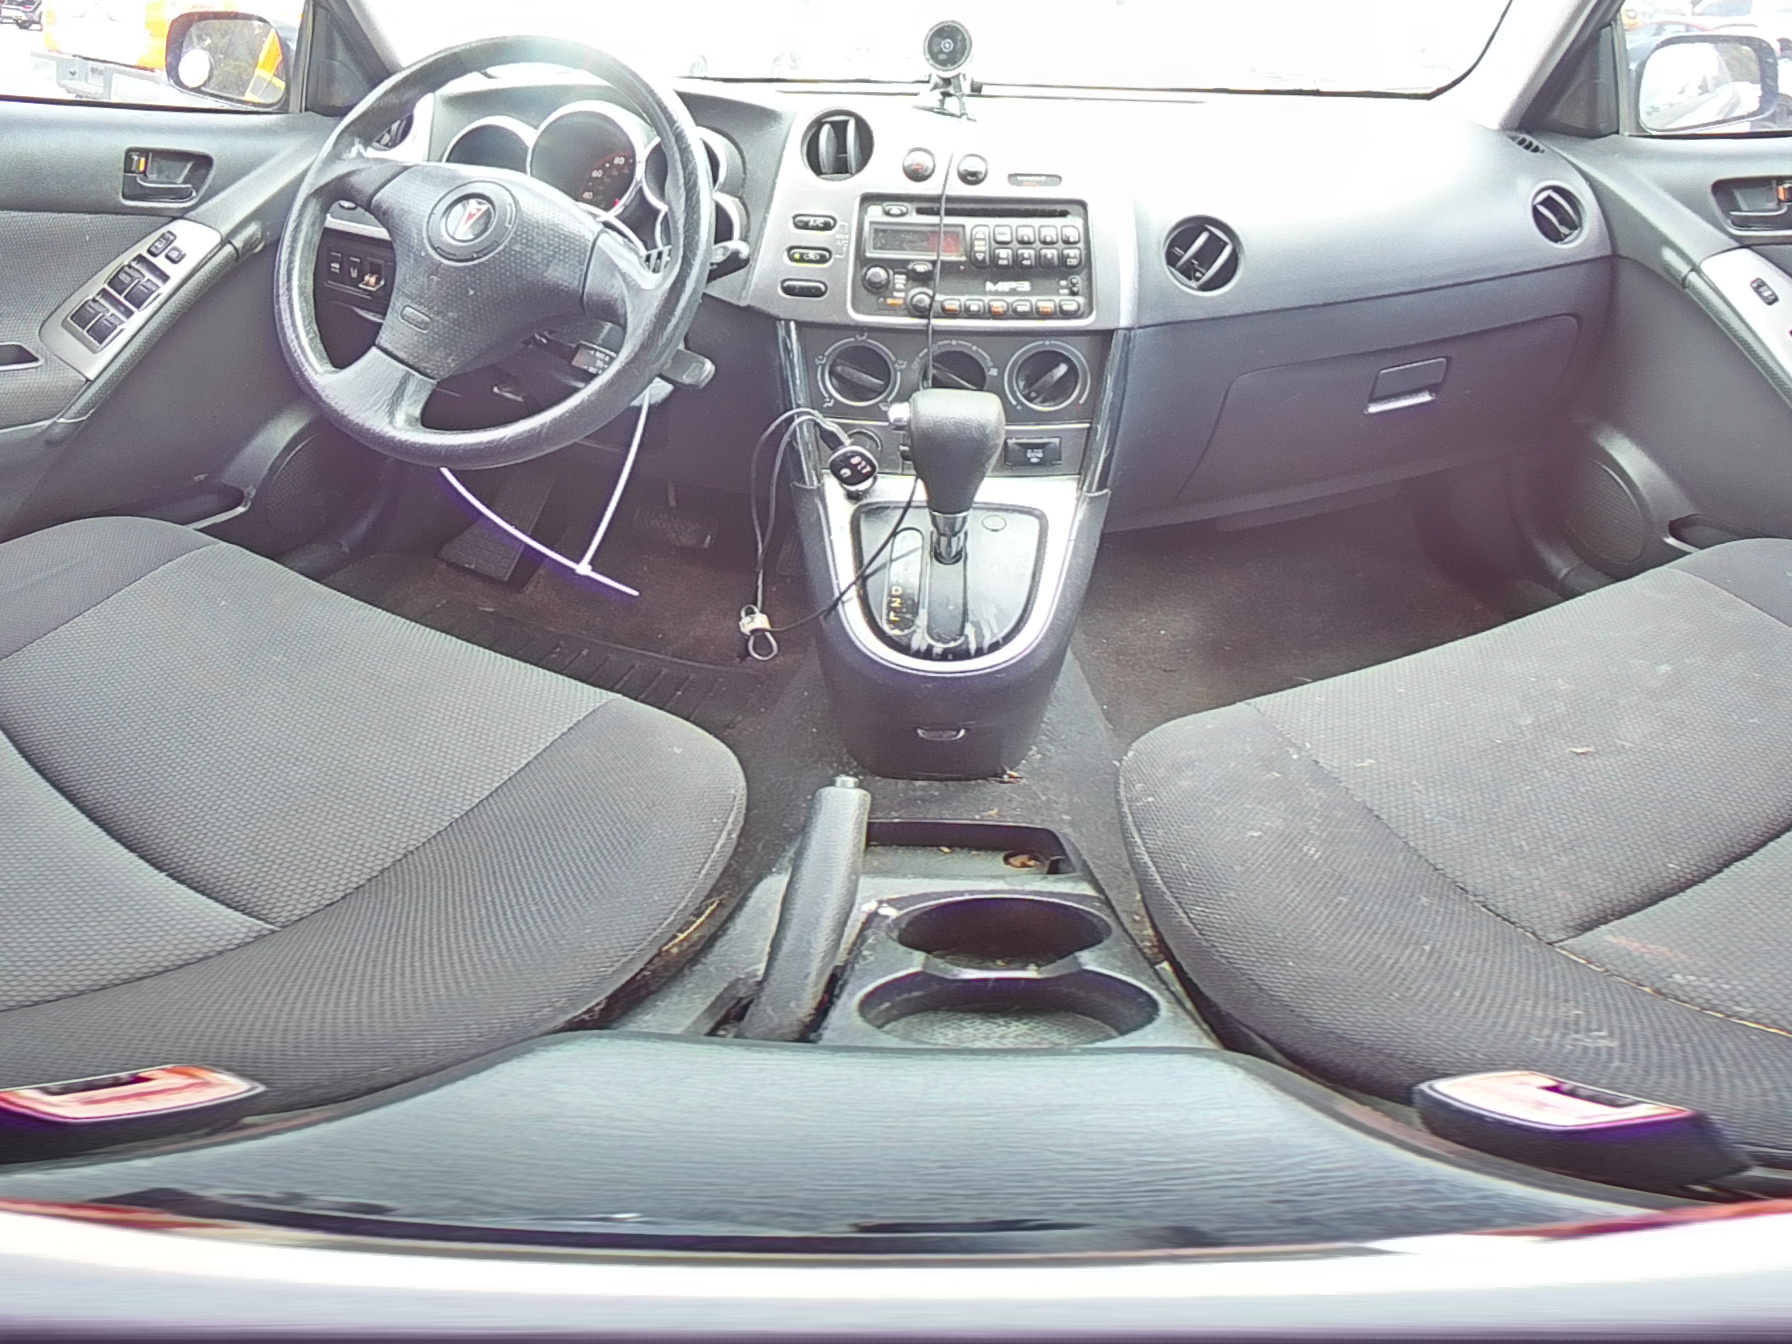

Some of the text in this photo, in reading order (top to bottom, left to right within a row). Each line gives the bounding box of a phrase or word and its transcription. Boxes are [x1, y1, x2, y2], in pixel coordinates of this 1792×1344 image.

[613, 156, 625, 165] 80
[591, 169, 603, 178] 60
[985, 280, 1031, 292] MP3
